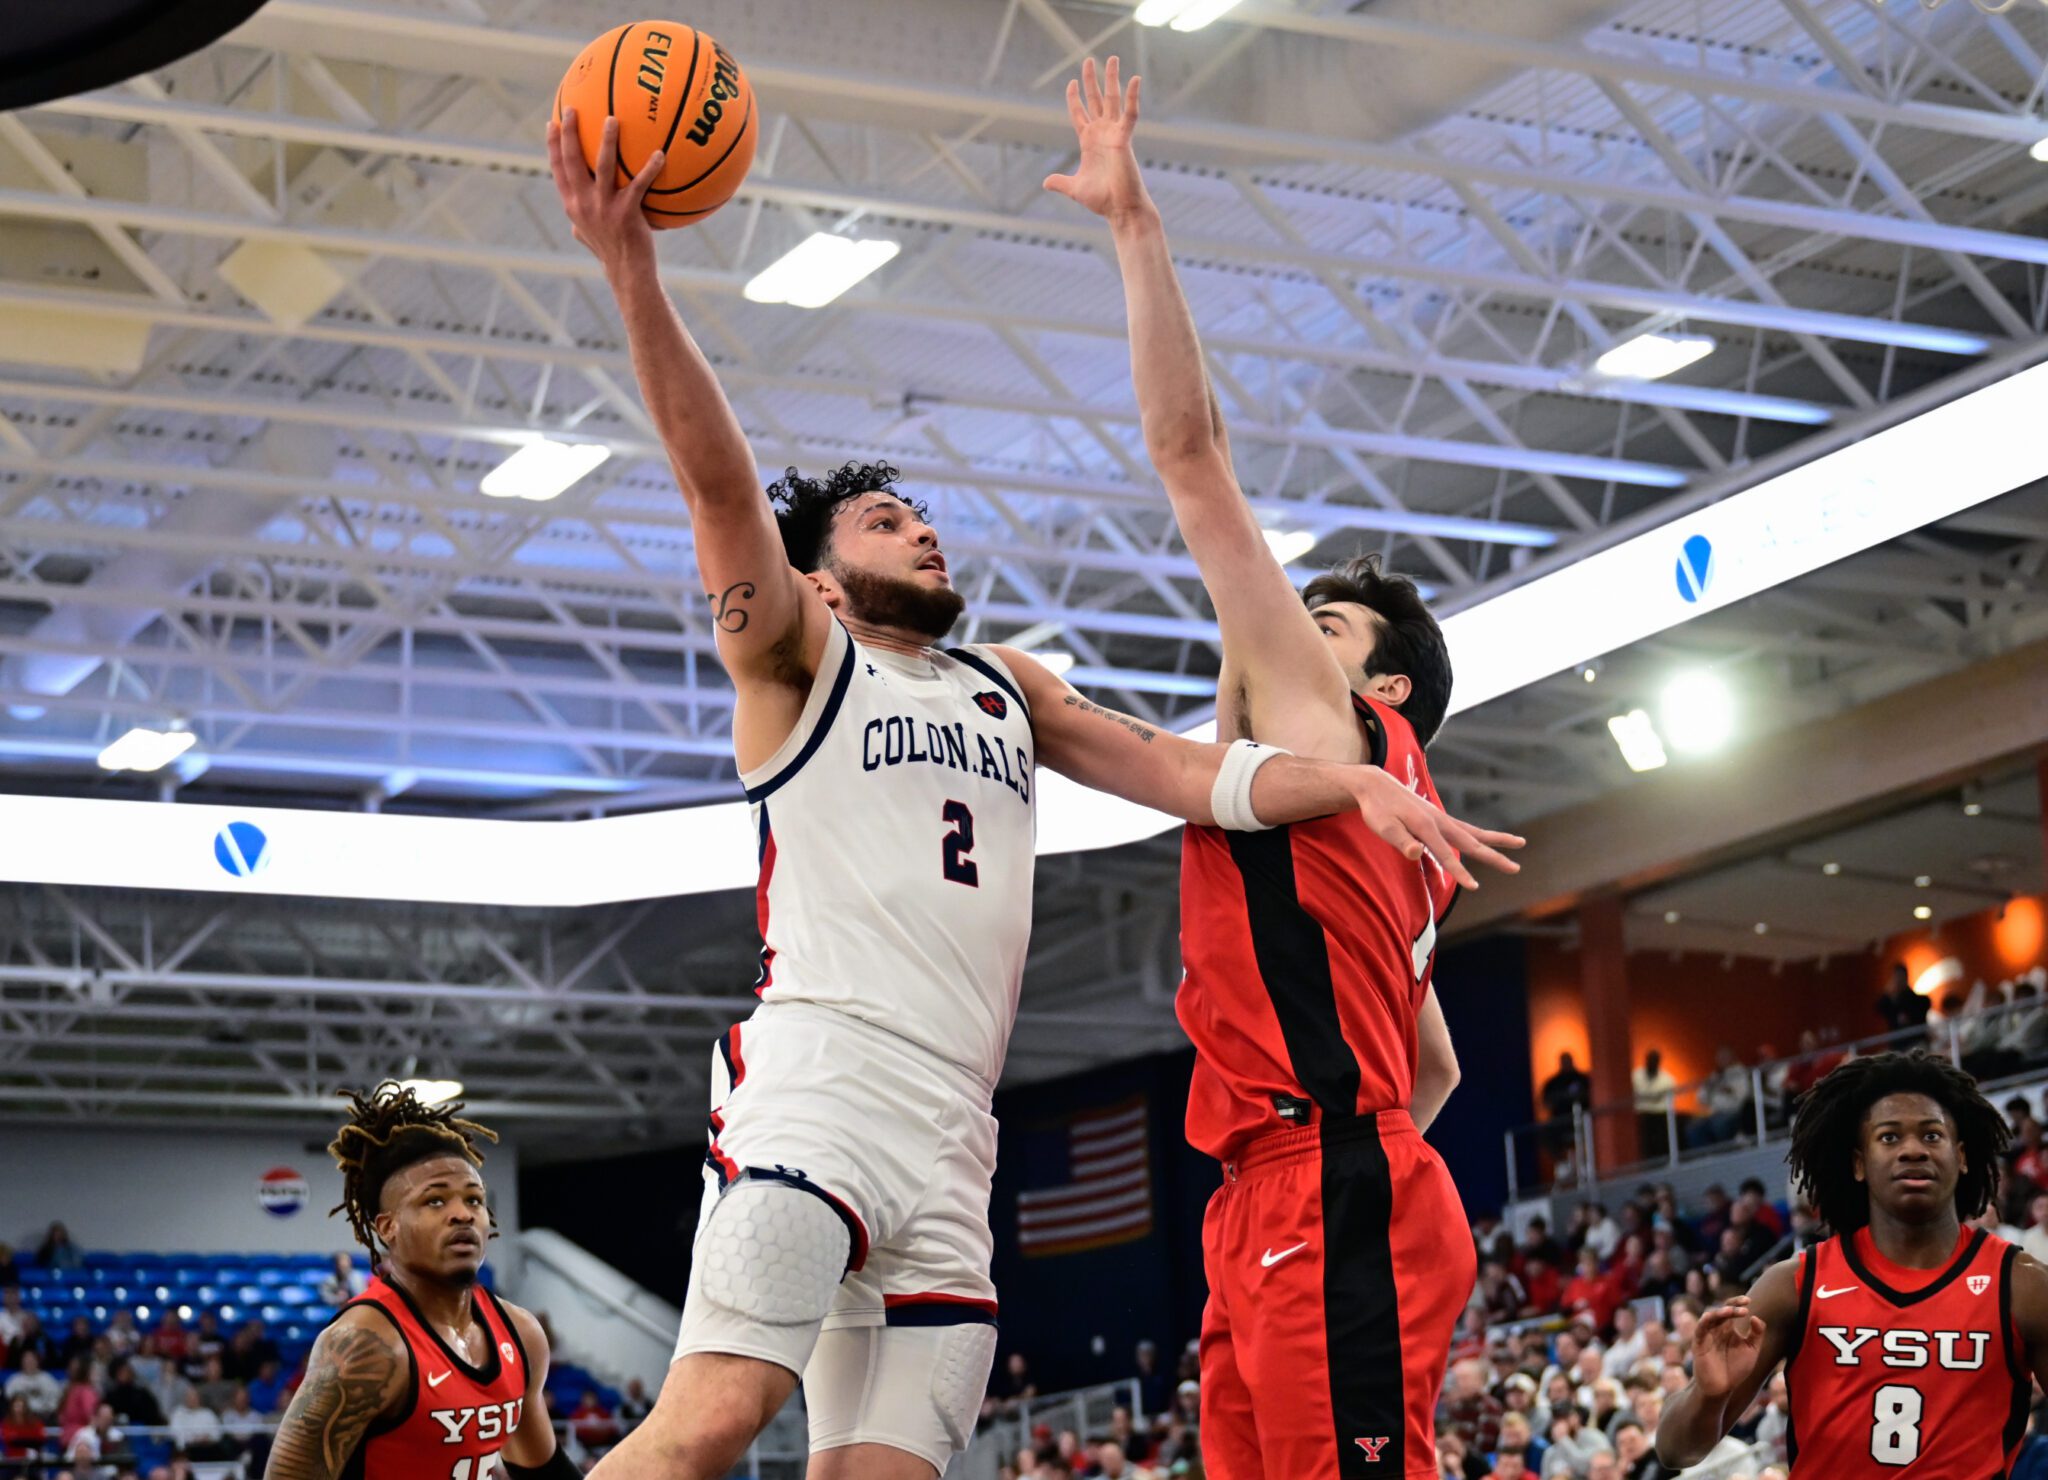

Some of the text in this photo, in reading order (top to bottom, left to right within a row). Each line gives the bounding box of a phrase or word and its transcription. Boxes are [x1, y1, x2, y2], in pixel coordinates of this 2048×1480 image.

[637, 30, 673, 95] EVO
[863, 715, 1029, 805] COLONALS
[942, 799, 979, 888] 2
[1817, 1325, 1991, 1370] YSU
[430, 1397, 524, 1443] YSU
[1354, 1436, 1390, 1462] Y
[1870, 1384, 1924, 1467] 8
